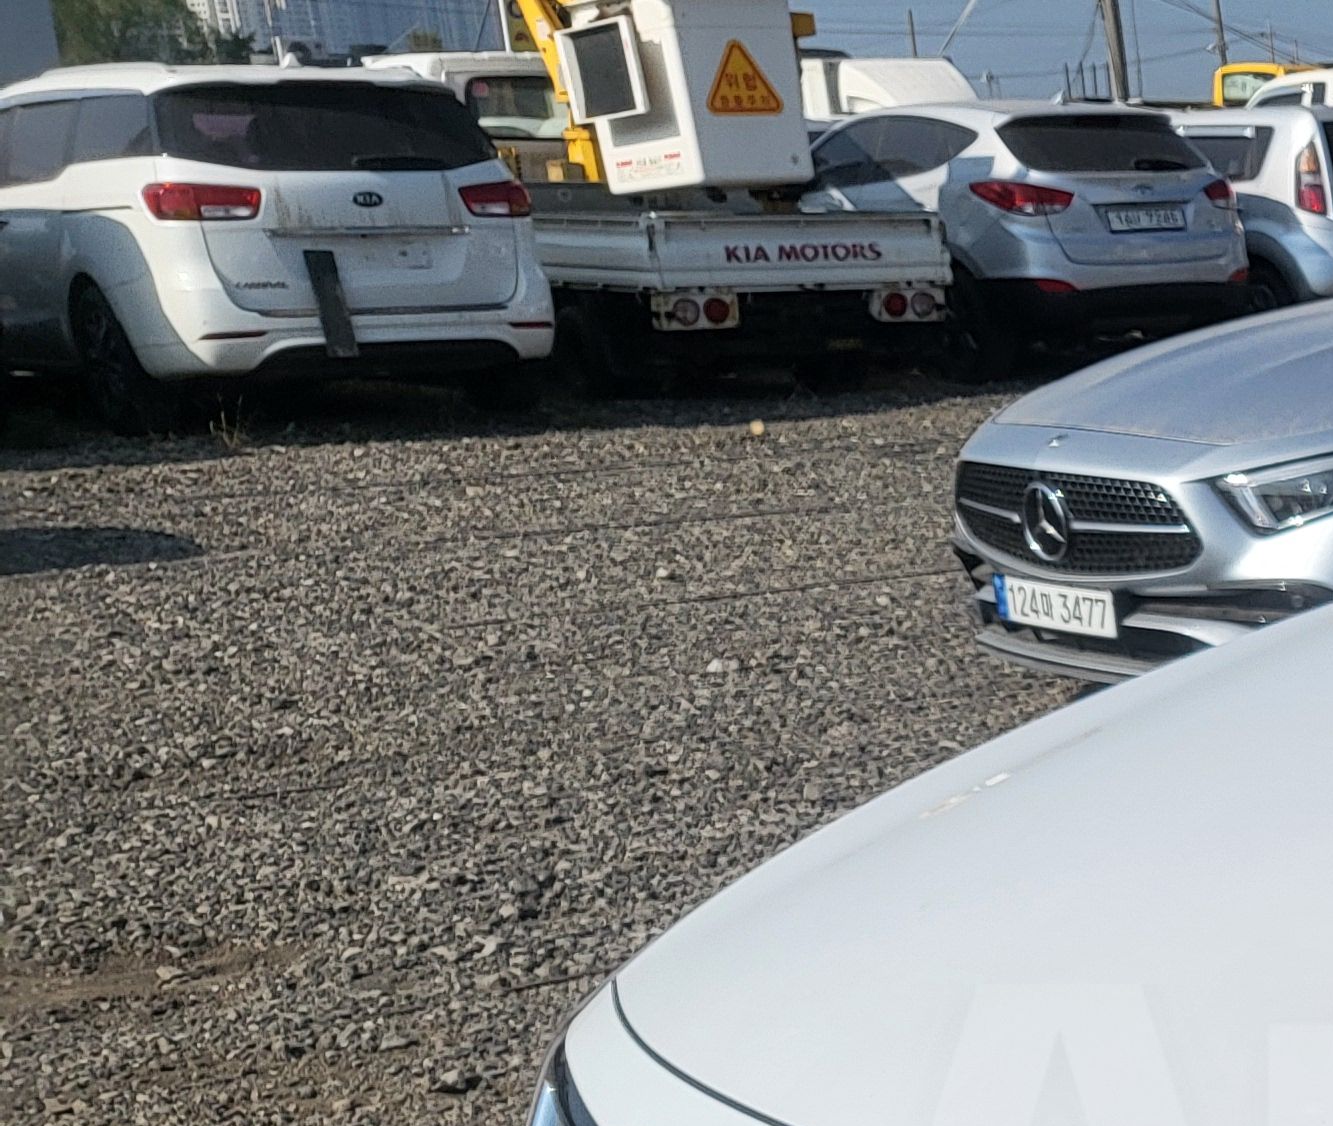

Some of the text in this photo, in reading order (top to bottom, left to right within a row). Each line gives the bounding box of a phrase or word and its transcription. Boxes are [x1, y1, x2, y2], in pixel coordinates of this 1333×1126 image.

[724, 242, 883, 264] KIA MOTORS
[1058, 593, 1106, 629] 3477
